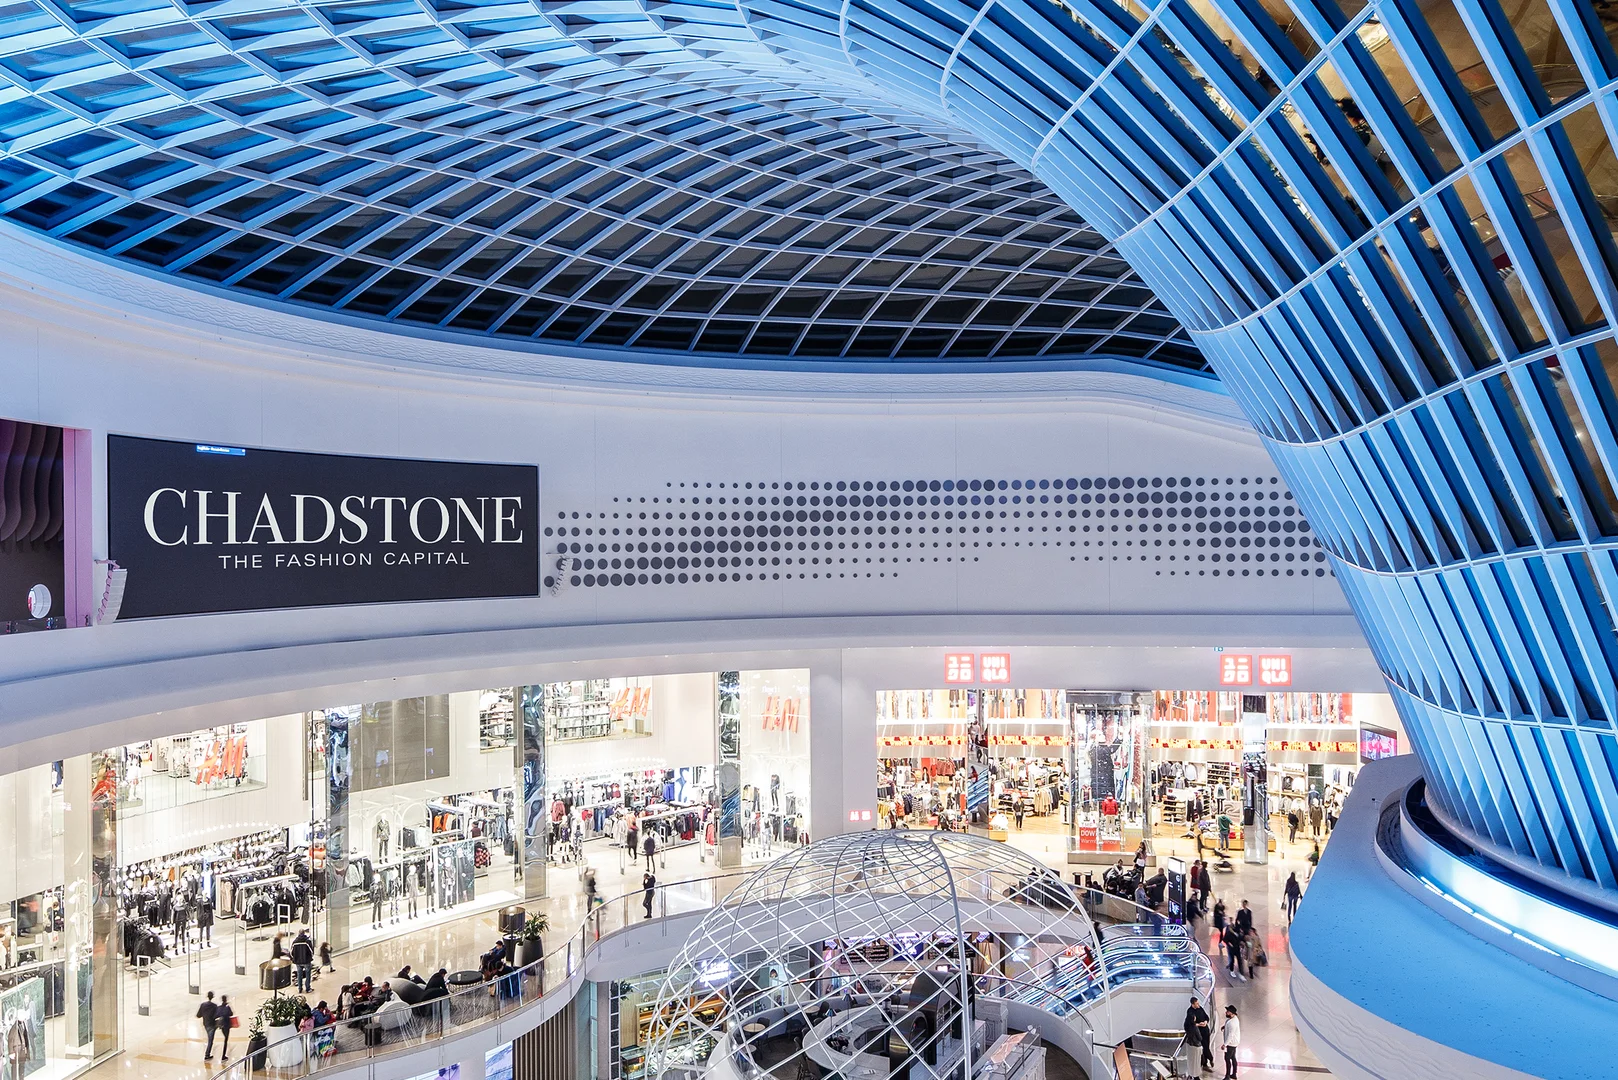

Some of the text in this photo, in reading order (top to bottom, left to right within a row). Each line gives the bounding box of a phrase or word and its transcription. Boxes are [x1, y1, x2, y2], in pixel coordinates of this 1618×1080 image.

[143, 487, 523, 546] CHADSTONE
[218, 552, 470, 570] THE FASHION CAPITAL
[982, 656, 1006, 669] UNI
[1261, 657, 1286, 670] UNI
[982, 668, 1008, 682] QLO
[1261, 670, 1289, 684] QLO
[610, 687, 651, 719] H&M
[761, 696, 801, 734] H&M
[195, 735, 247, 785] H&M
